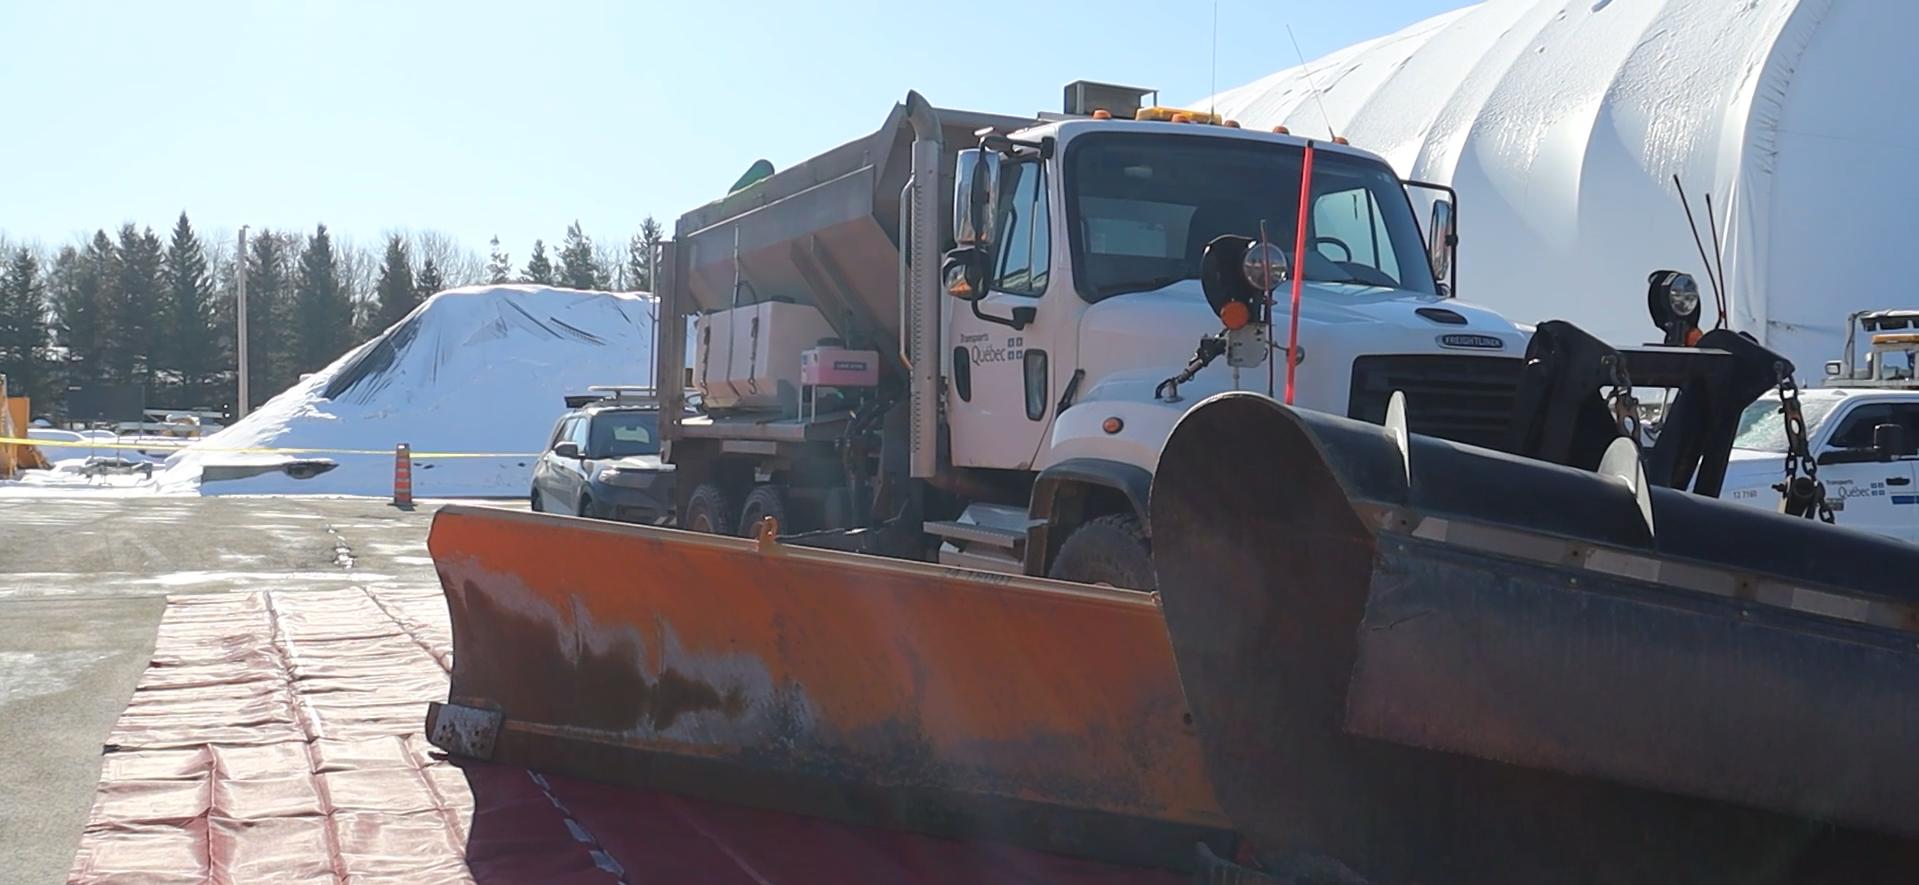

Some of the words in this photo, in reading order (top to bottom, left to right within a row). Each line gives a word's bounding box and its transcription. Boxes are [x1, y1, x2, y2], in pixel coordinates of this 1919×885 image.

[1444, 336, 1502, 346] FREIGHTLINER
[971, 345, 1006, 366] Québec
[1838, 486, 1870, 500] Québec
